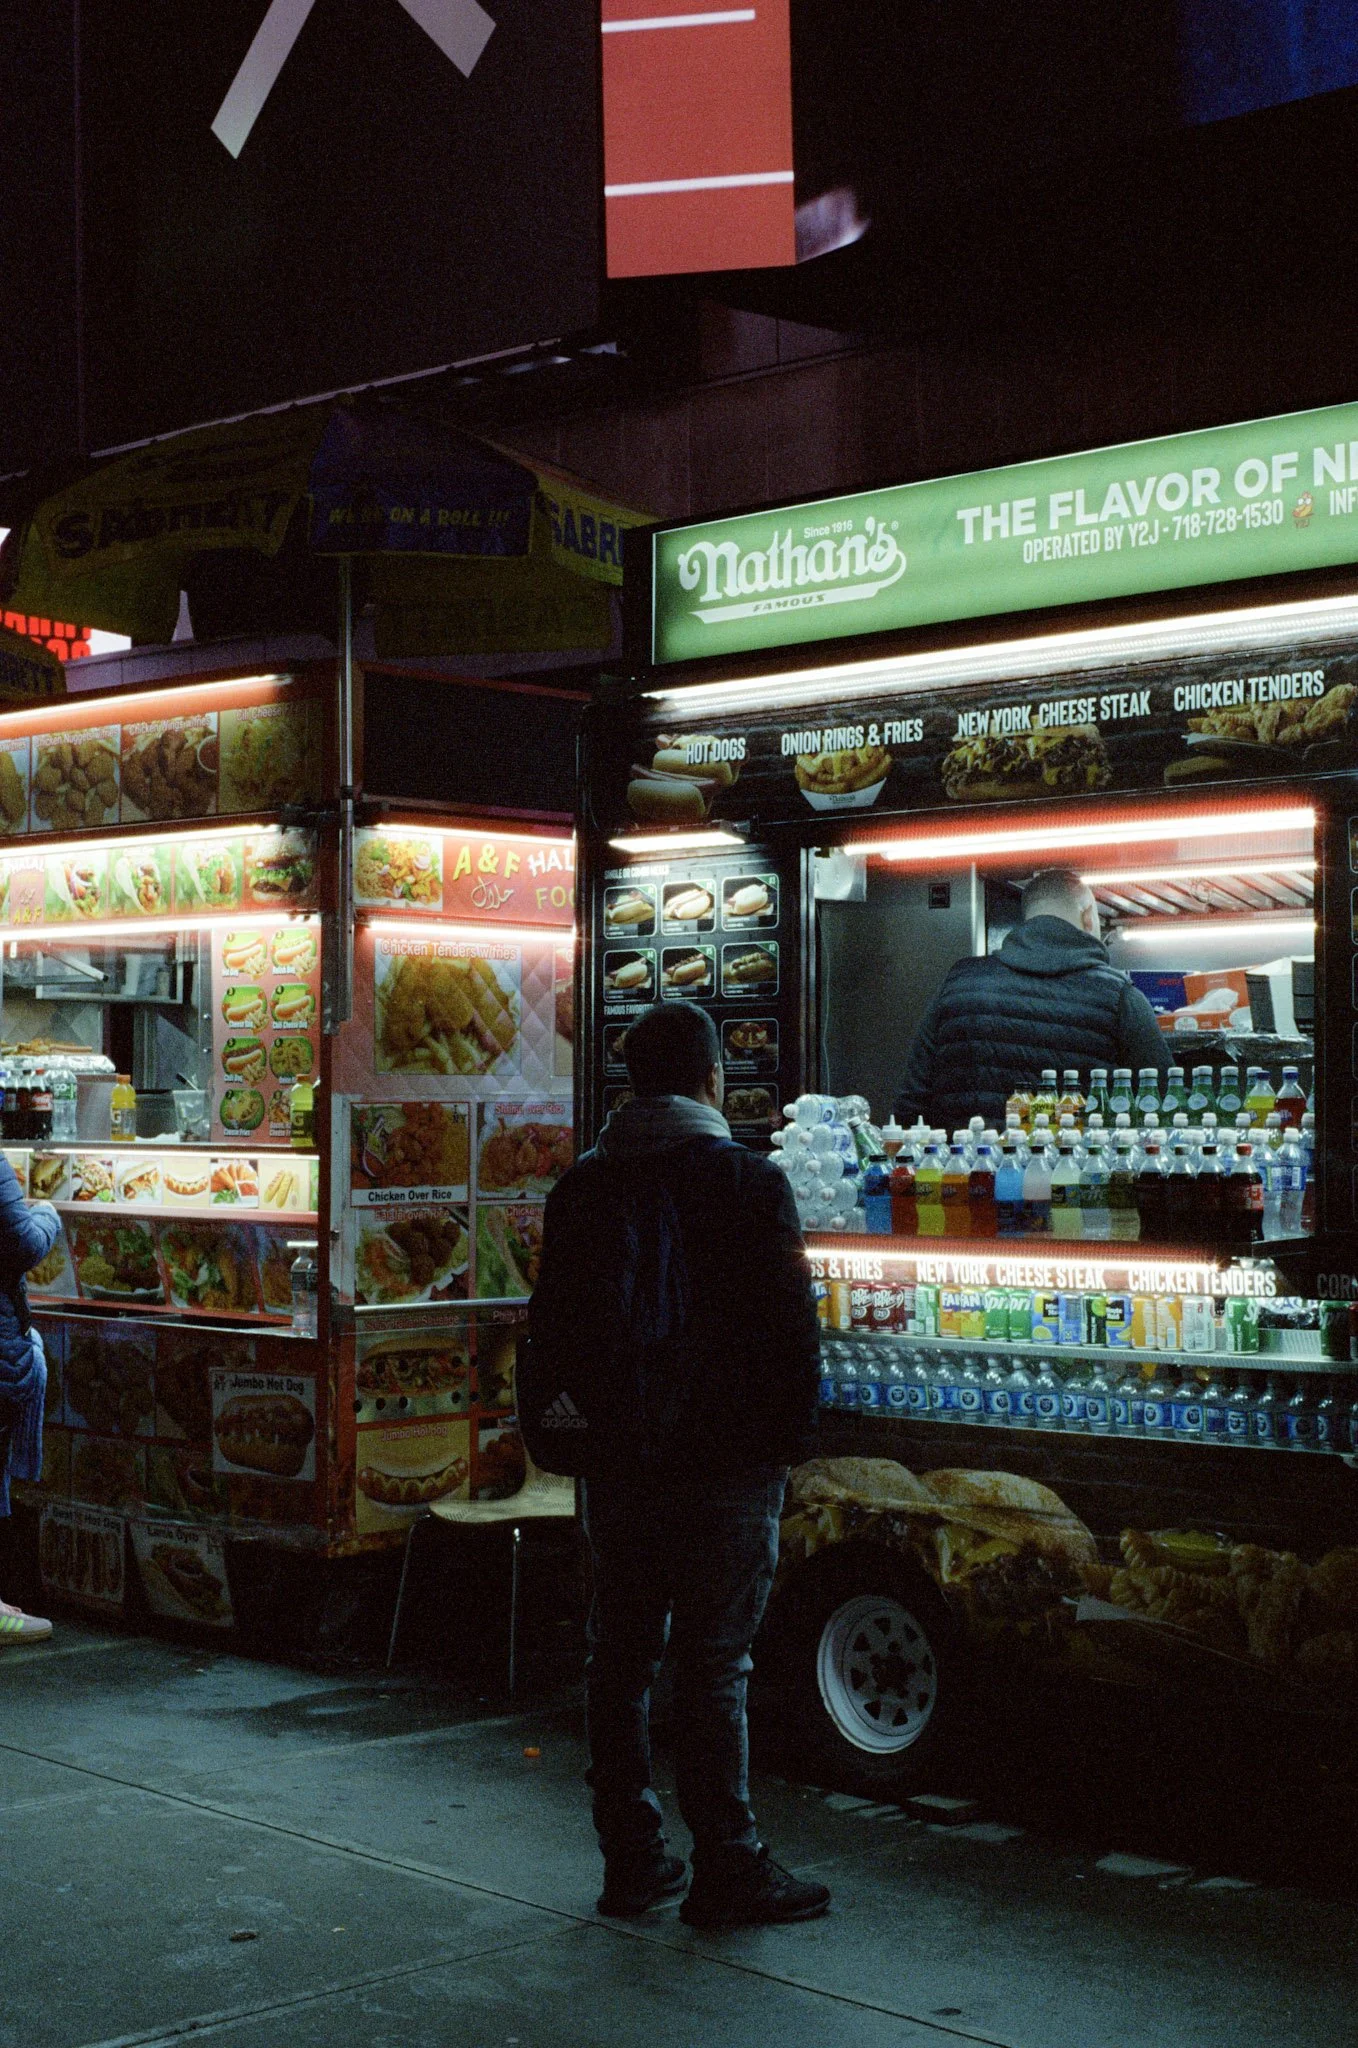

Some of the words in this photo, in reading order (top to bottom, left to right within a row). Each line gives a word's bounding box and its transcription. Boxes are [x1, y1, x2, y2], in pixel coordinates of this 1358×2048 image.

[957, 498, 1037, 544] THE
[1049, 468, 1220, 530] FLAVOR
[1234, 452, 1299, 498] OF
[550, 500, 625, 566] SABR
[803, 526, 830, 539] Since
[831, 519, 853, 533] 1916
[1023, 530, 1100, 563] OPERATED
[1104, 527, 1123, 552] BY
[1128, 519, 1159, 549] Y2J
[1174, 498, 1284, 541] 718-728-1530
[678, 516, 906, 603] Nathan's
[753, 593, 826, 611] FAMOUS
[1173, 679, 1244, 712] CHICKEN
[1248, 669, 1325, 704] TENDERS
[957, 710, 990, 736] NEW
[992, 705, 1032, 734] YORK
[1038, 697, 1097, 728] CHEESE
[1100, 691, 1151, 721] STEAK
[686, 742, 711, 764] HOT
[713, 737, 746, 761] DOGS
[781, 730, 821, 756] ONION
[824, 726, 864, 751] RINGS
[868, 723, 880, 746] &
[884, 718, 923, 745] FRIES
[453, 844, 472, 881] A
[478, 843, 499, 874] &
[503, 850, 521, 879] F
[470, 876, 515, 910] حلال
[536, 885, 575, 910] FO
[380, 939, 428, 957] Chicken
[432, 942, 477, 958] Tenders
[368, 1190, 406, 1203] Chicken
[408, 1190, 429, 1202] Over
[432, 1190, 452, 1201] Rice
[828, 1257, 841, 1278] &
[844, 1258, 883, 1280] FRIES
[916, 1260, 947, 1283] NEW
[950, 1262, 989, 1284] YORK
[995, 1263, 1052, 1287] CHEESE
[1055, 1265, 1106, 1290] STEAK
[1128, 1268, 1197, 1293] CHICKEN
[1203, 1269, 1277, 1297] TENDERS
[232, 1374, 264, 1389] Jumbo
[286, 1378, 304, 1396] Dog
[380, 1428, 410, 1442] Jumbo
[413, 1425, 428, 1438] Hot
[431, 1425, 447, 1439] Dog
[540, 1414, 588, 1430] adidas
